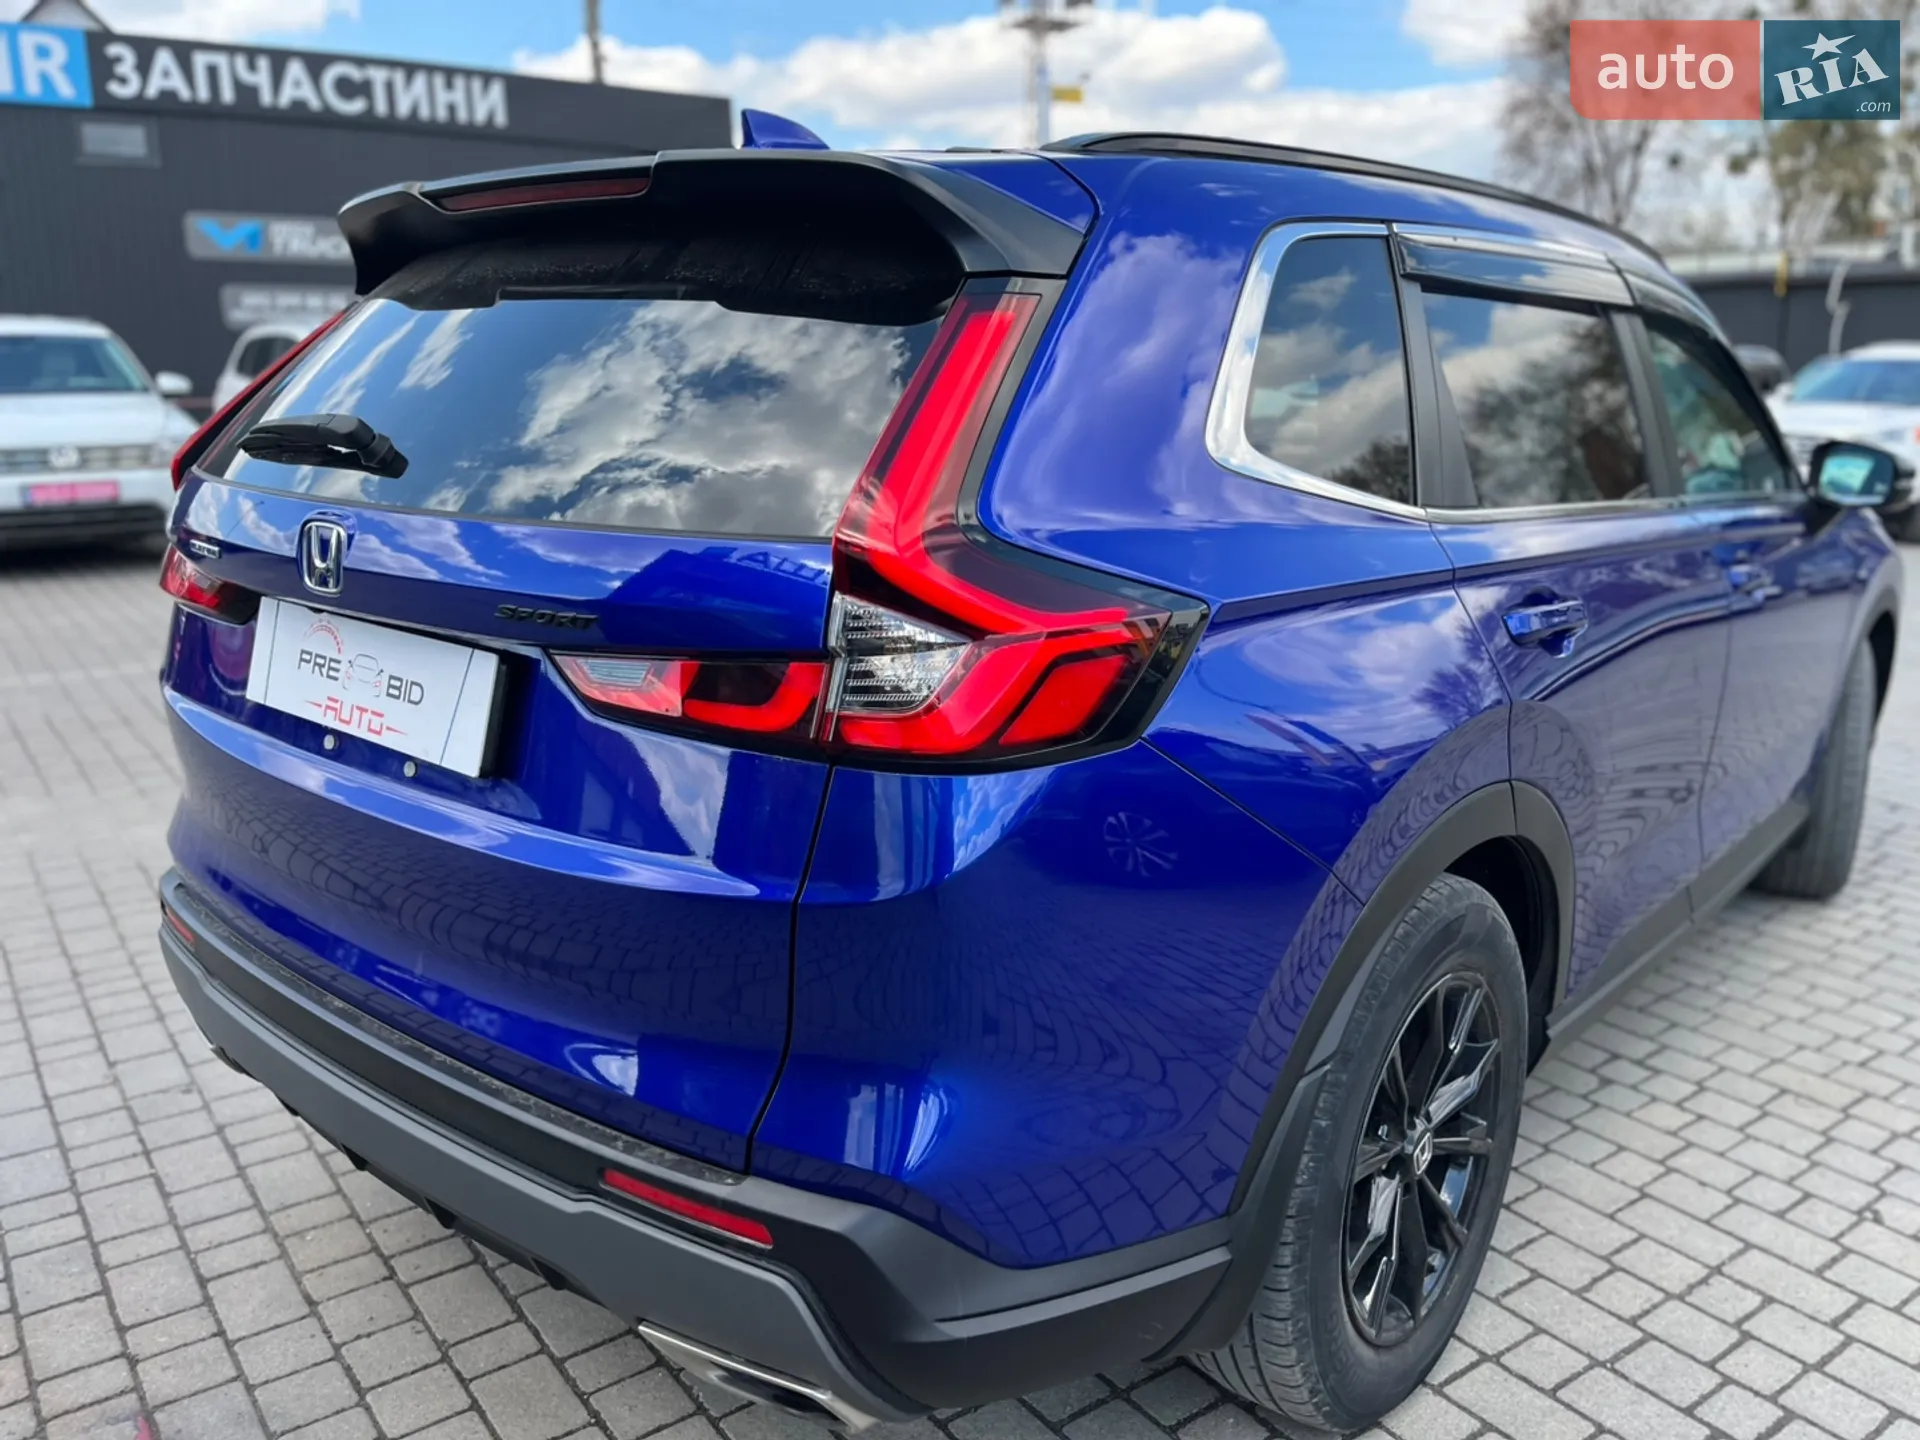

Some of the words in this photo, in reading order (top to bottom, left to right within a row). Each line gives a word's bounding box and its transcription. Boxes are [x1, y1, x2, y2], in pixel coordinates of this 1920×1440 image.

[104, 41, 509, 129] ЗАПЧАСТИНИ
[494, 604, 599, 630] SPORT
[297, 648, 343, 682] PRE
[385, 674, 425, 706] BID
[323, 695, 385, 737] AUTO
